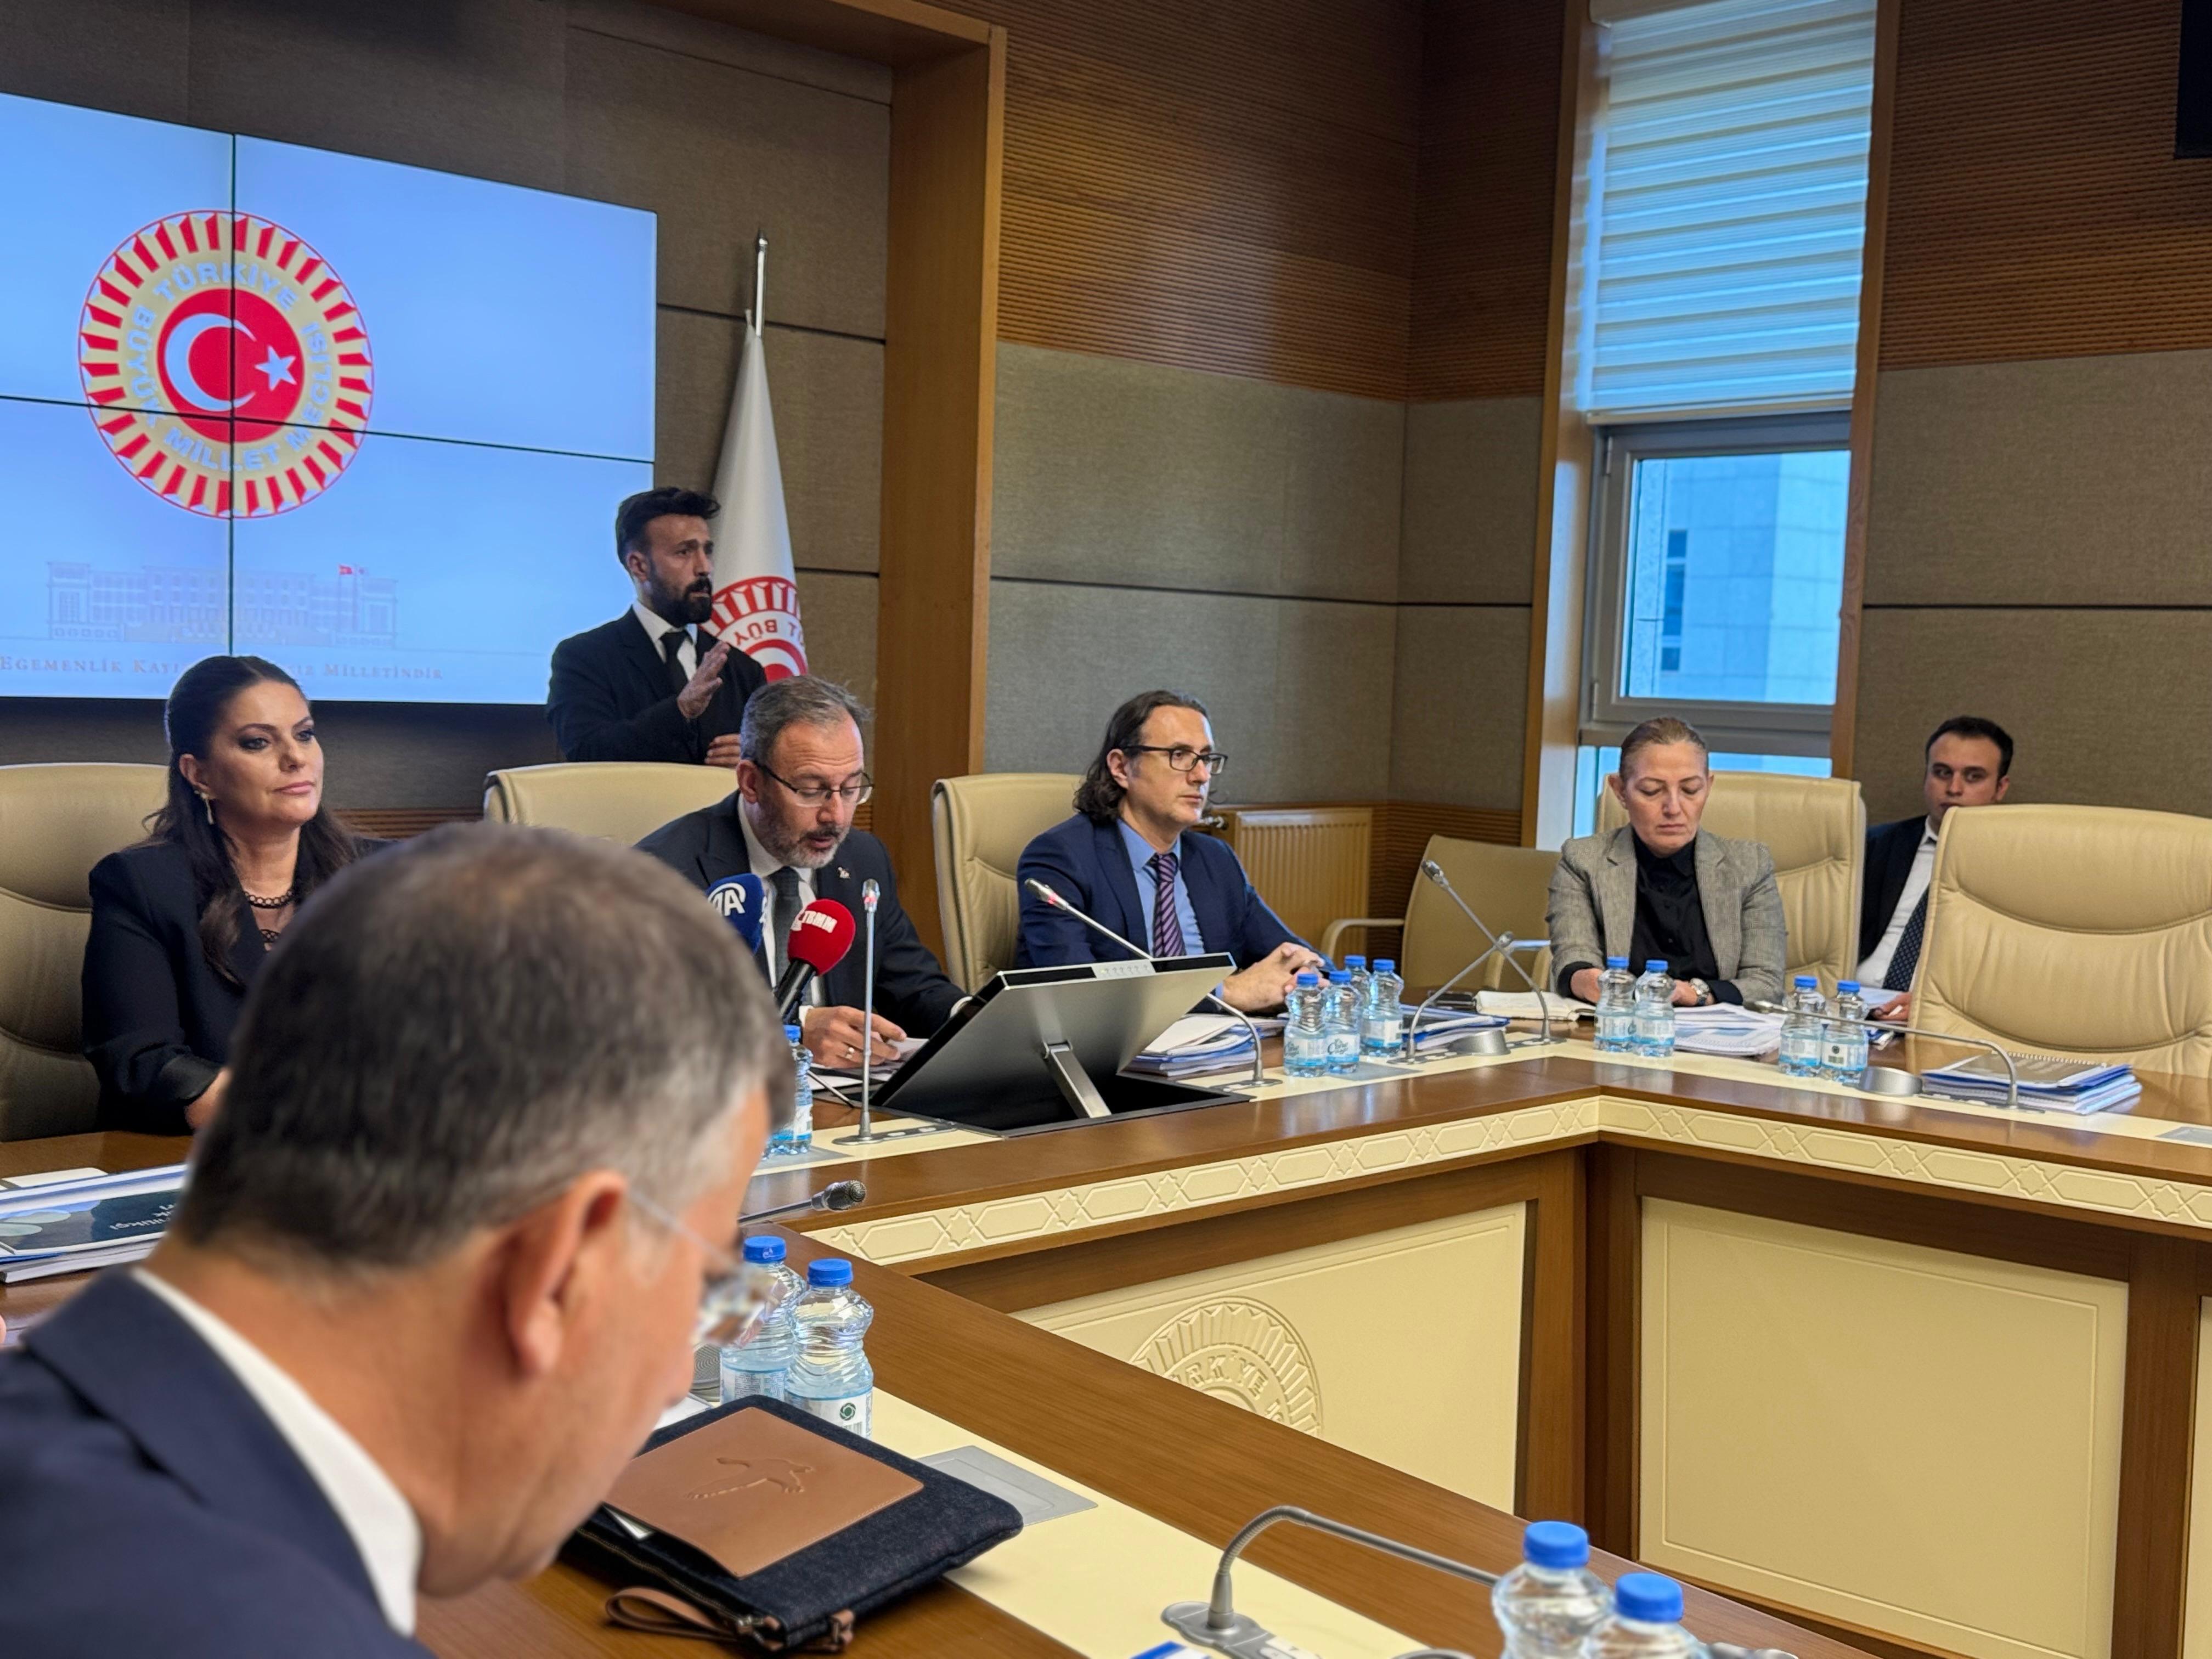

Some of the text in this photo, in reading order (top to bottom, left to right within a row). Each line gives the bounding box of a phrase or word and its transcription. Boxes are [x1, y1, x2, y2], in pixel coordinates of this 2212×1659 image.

[152, 261, 299, 311] TÜRKİYE
[126, 304, 165, 428] BÜYÜK
[164, 428, 281, 472] MİLLET
[733, 618, 778, 646] BÜY
